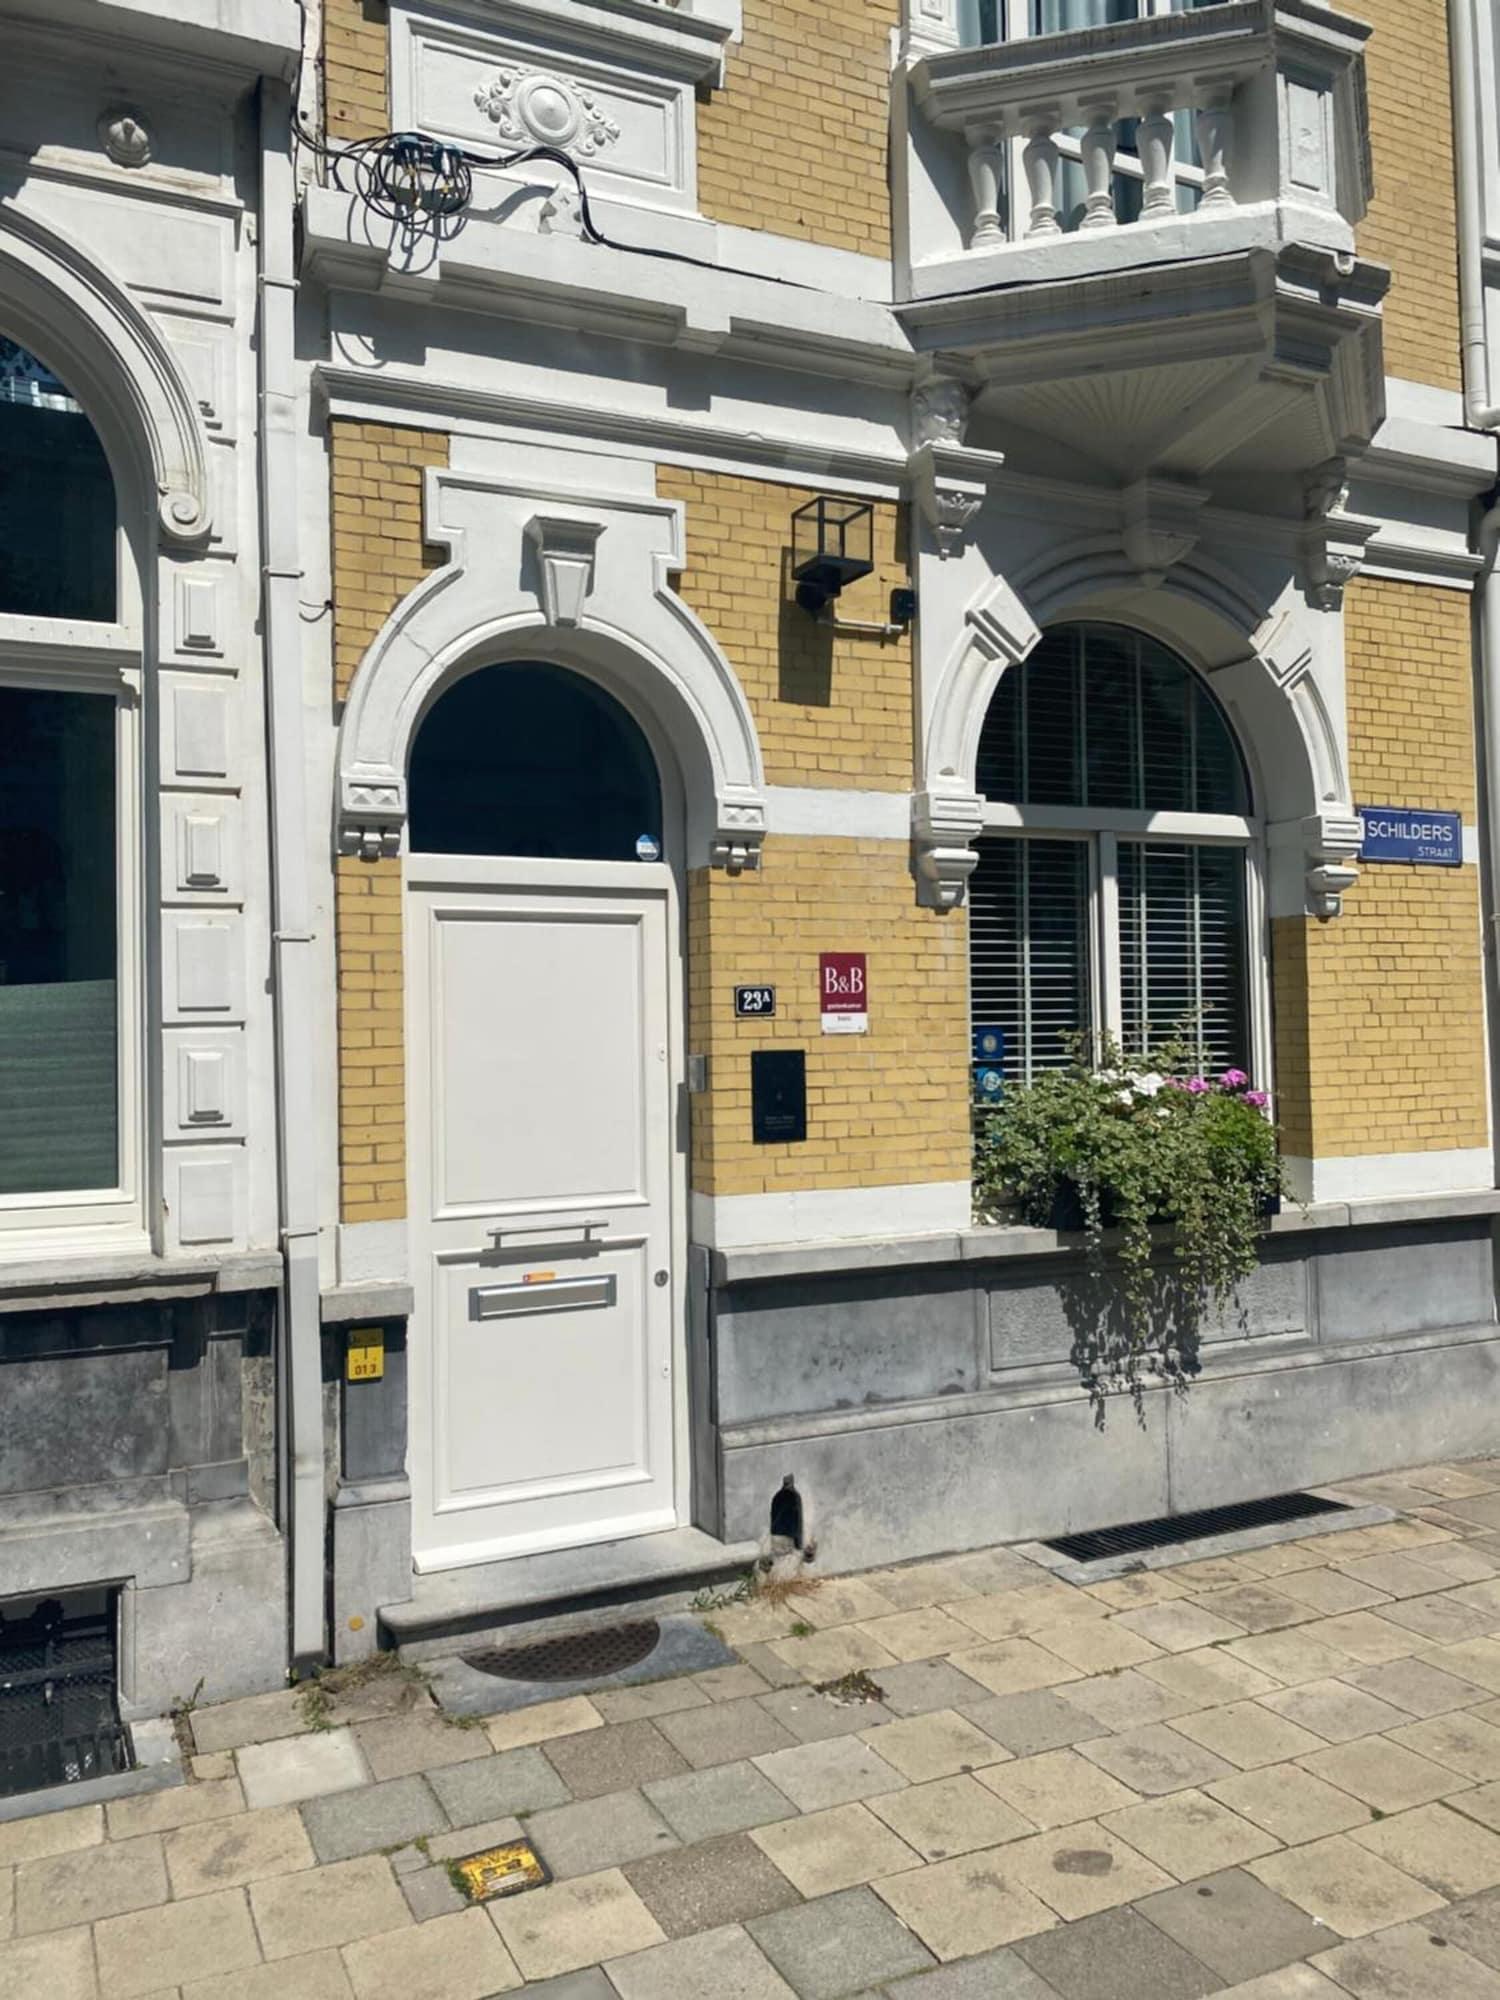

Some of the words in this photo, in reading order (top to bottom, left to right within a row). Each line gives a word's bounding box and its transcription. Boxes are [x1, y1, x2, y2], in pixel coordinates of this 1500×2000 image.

[1367, 821, 1453, 842] SCHILDERS
[1417, 846, 1454, 858] STRAAT
[825, 967, 864, 994] B&B
[743, 991, 771, 1010] 23A
